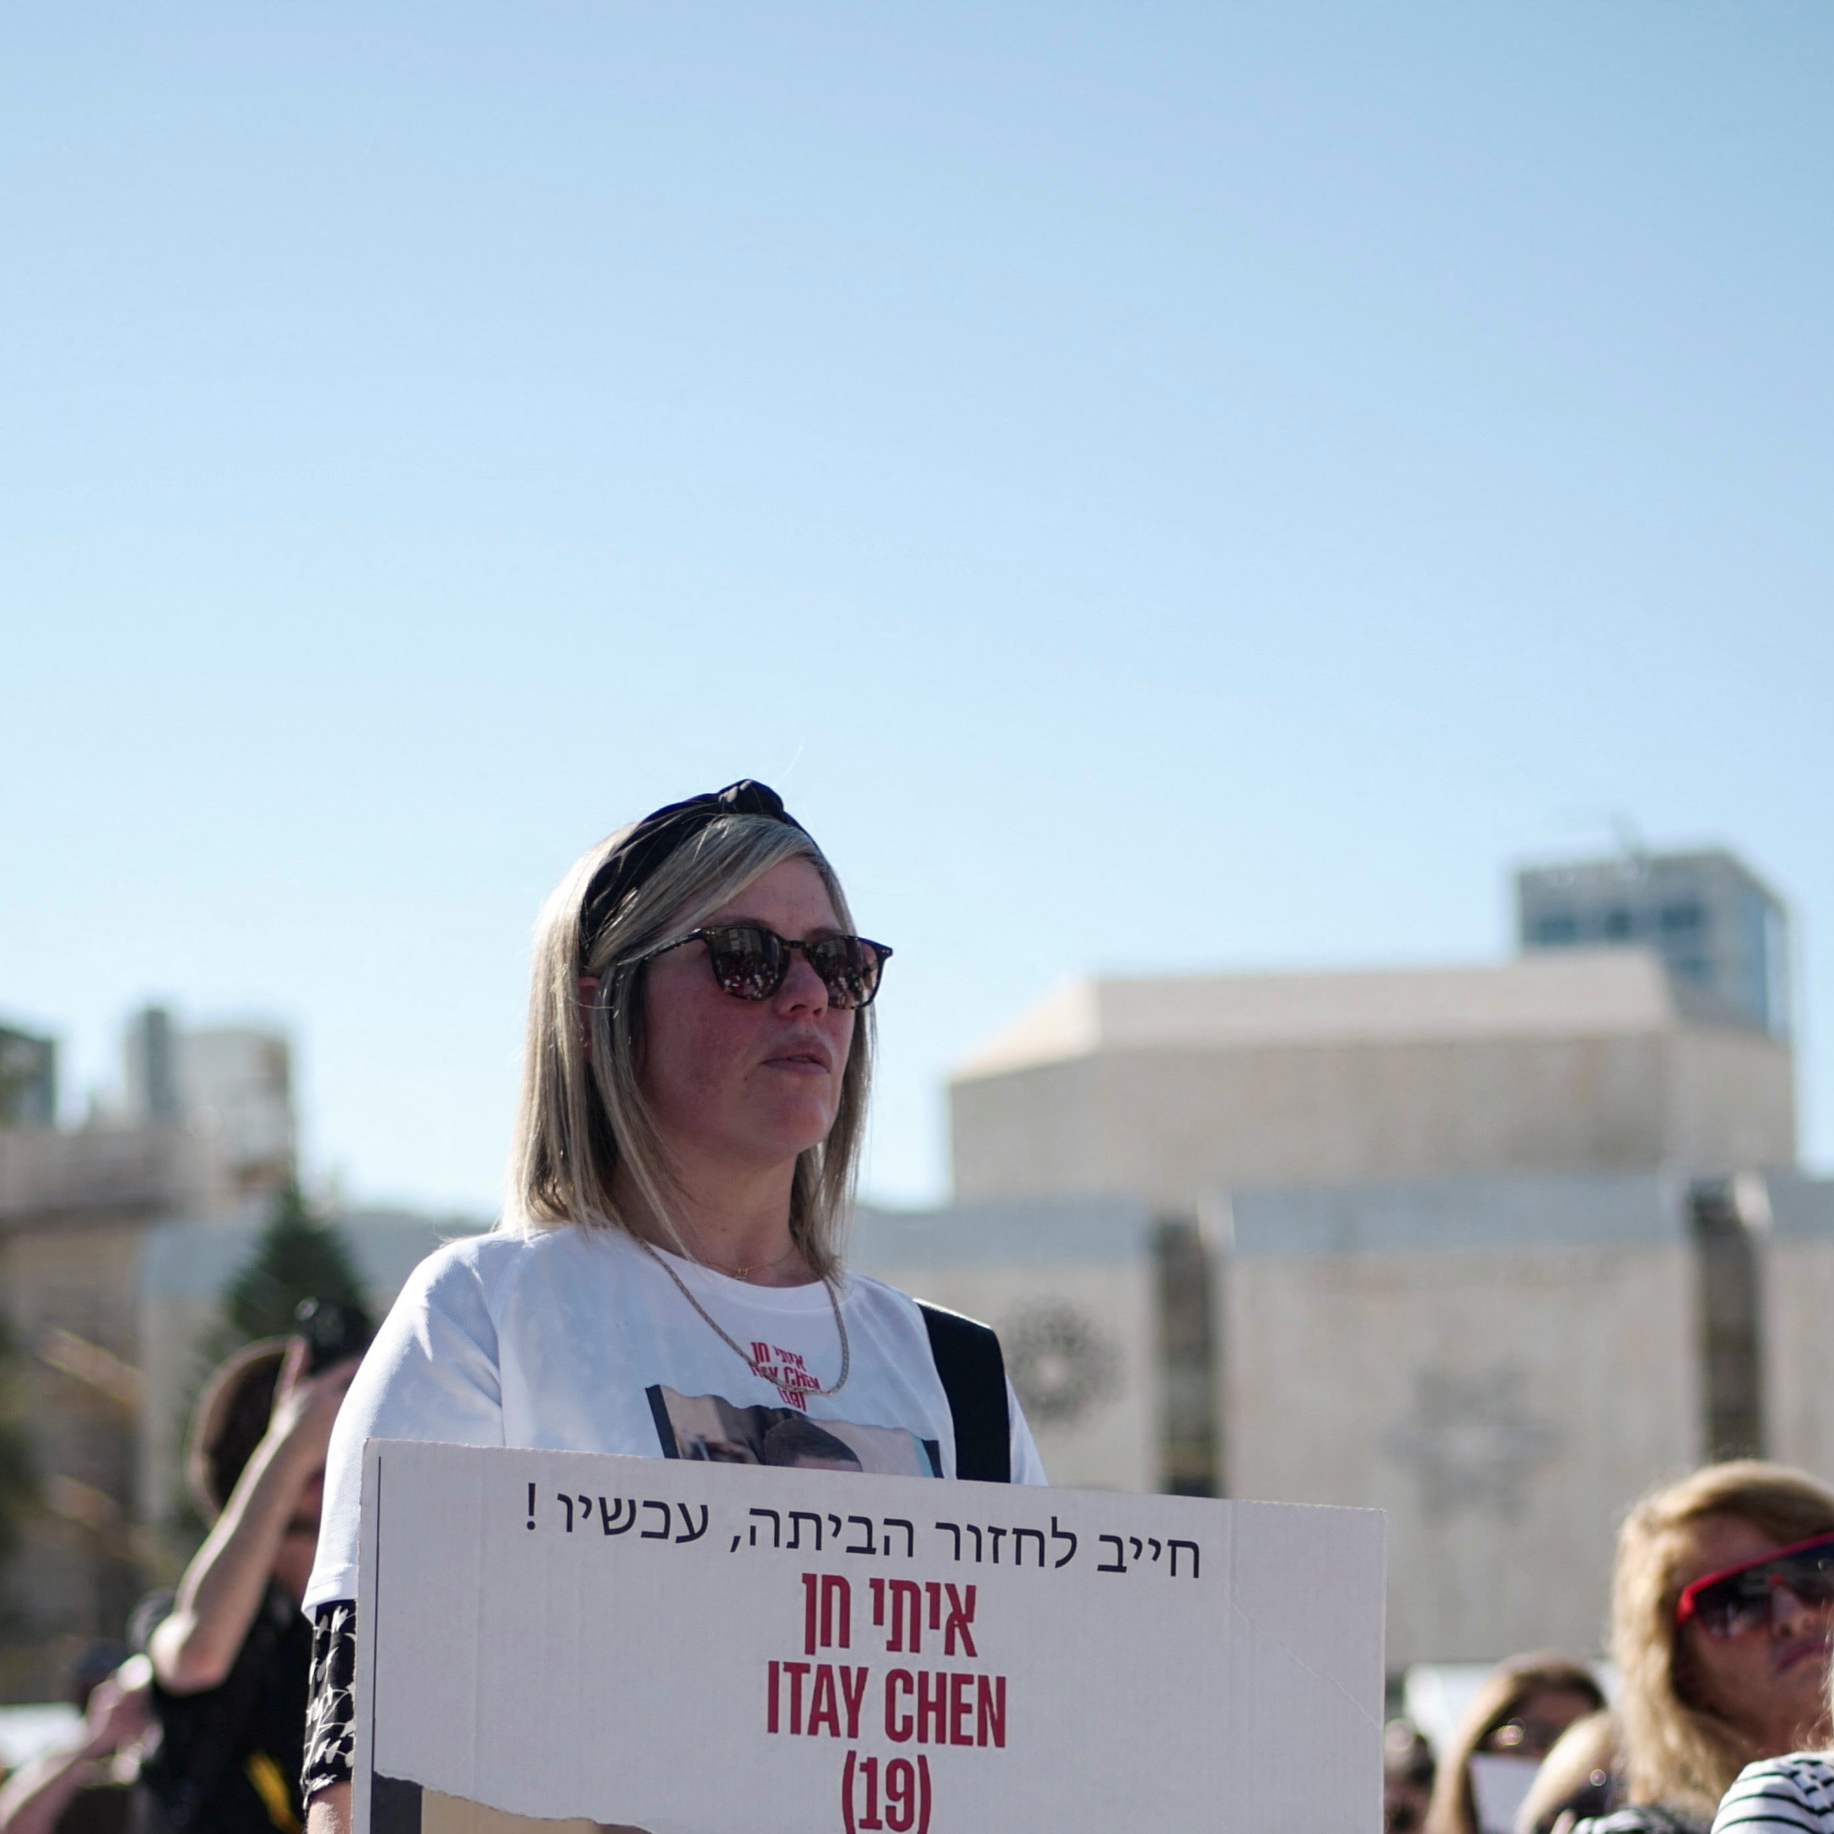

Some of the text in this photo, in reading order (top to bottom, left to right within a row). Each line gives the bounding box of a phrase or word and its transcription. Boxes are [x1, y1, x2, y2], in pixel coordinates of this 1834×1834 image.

[750, 1341, 771, 1364] חן
[729, 1507, 915, 1558] הביתה,
[934, 1516, 1078, 1569] לחזור
[1097, 1534, 1201, 1579] חייב
[801, 1572, 978, 1658] איתי חן
[767, 1660, 1007, 1749] ITAY CHEN
